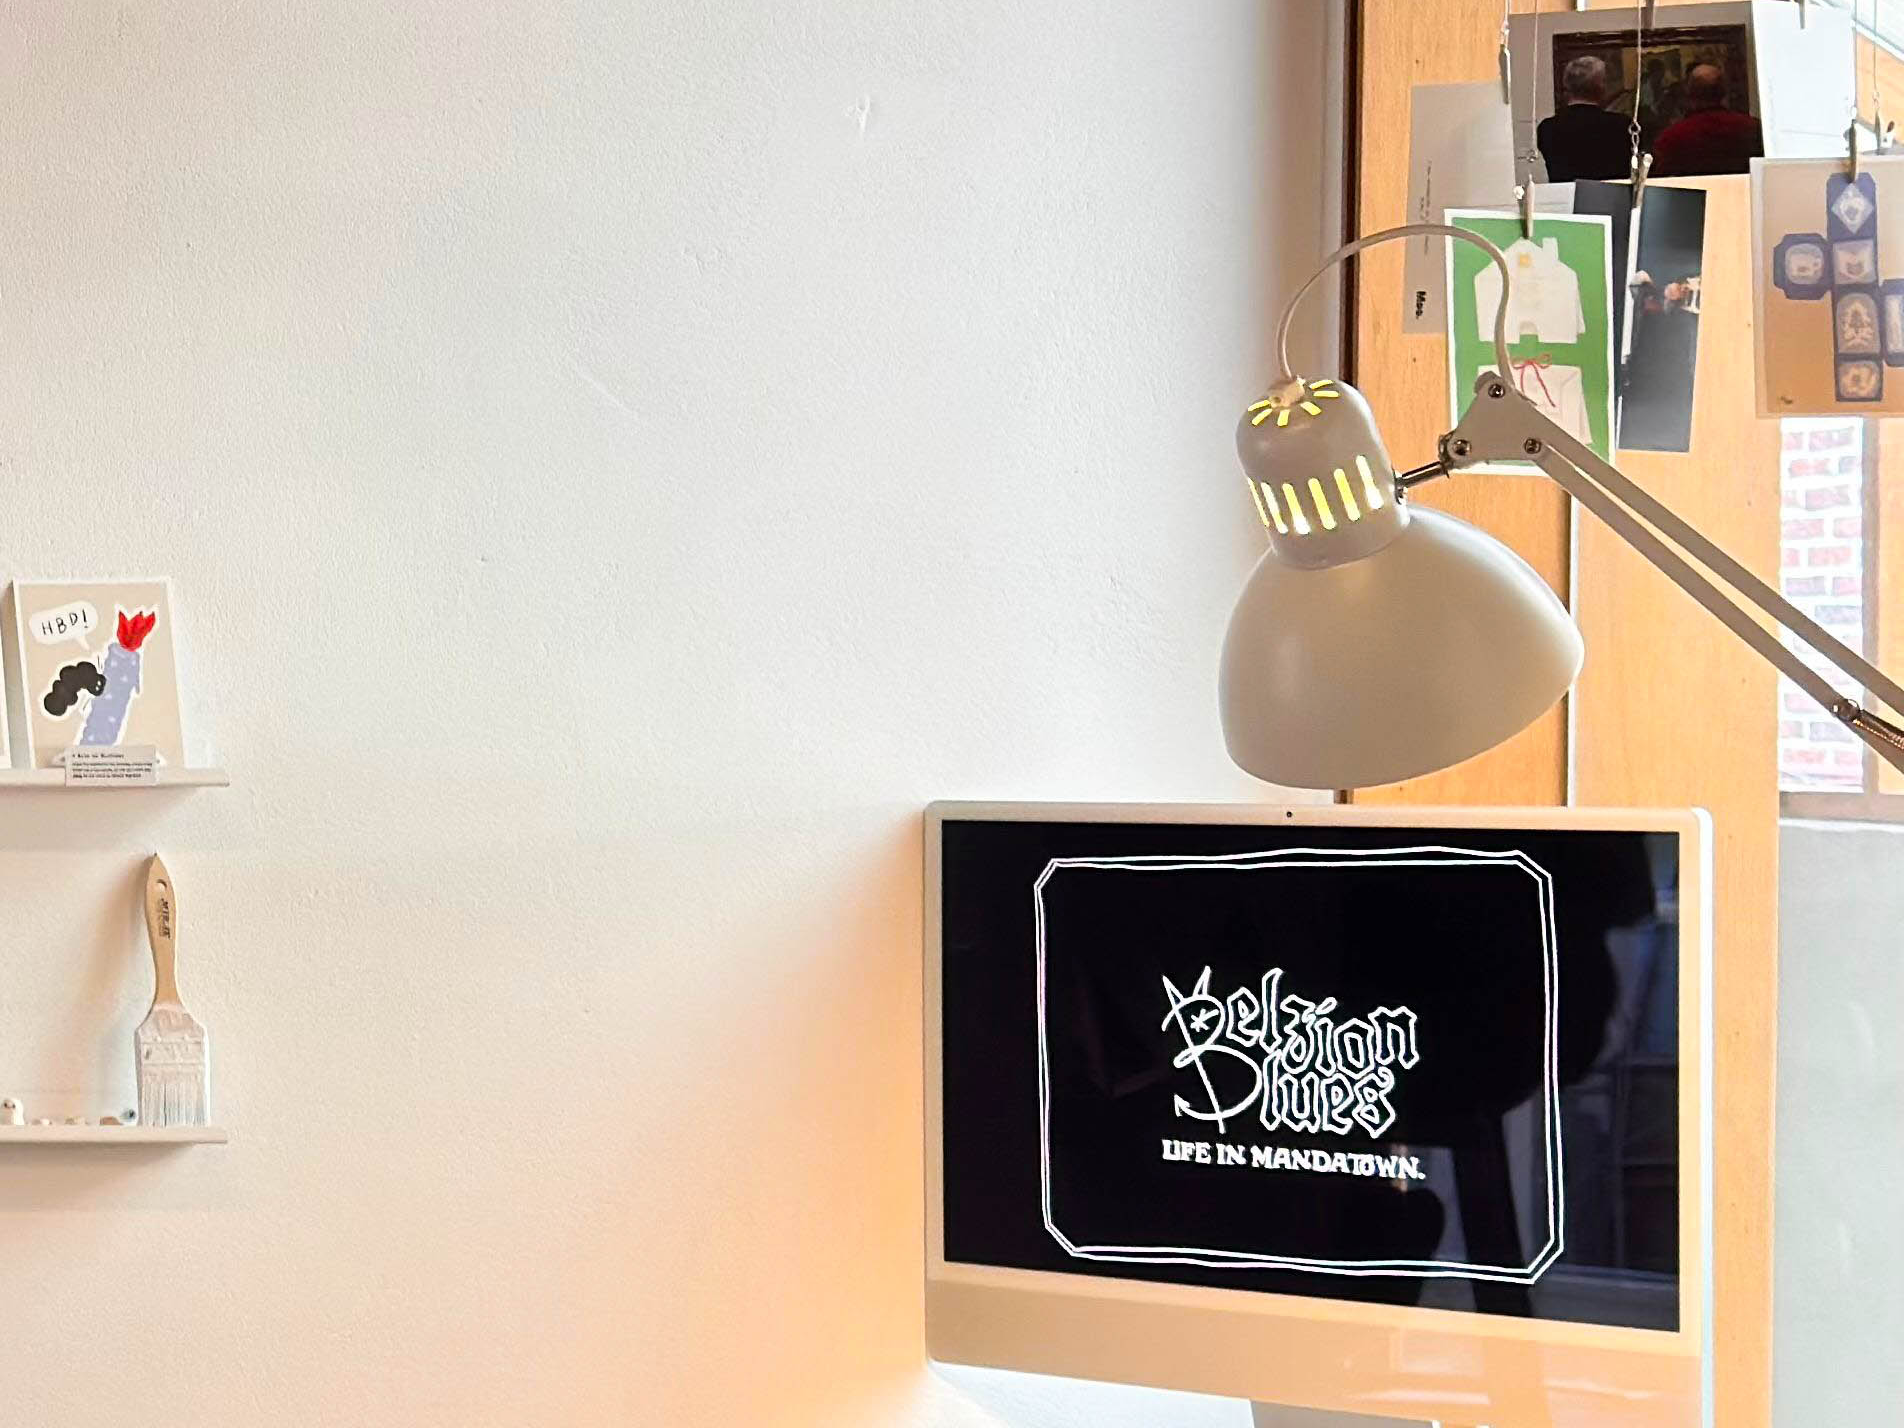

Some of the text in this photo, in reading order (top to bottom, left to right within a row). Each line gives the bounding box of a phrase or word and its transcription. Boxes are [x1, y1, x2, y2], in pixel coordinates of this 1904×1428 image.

[42, 608, 89, 636] HBD!
[1162, 1139, 1426, 1180] LIFE IN MANDATOWN.
